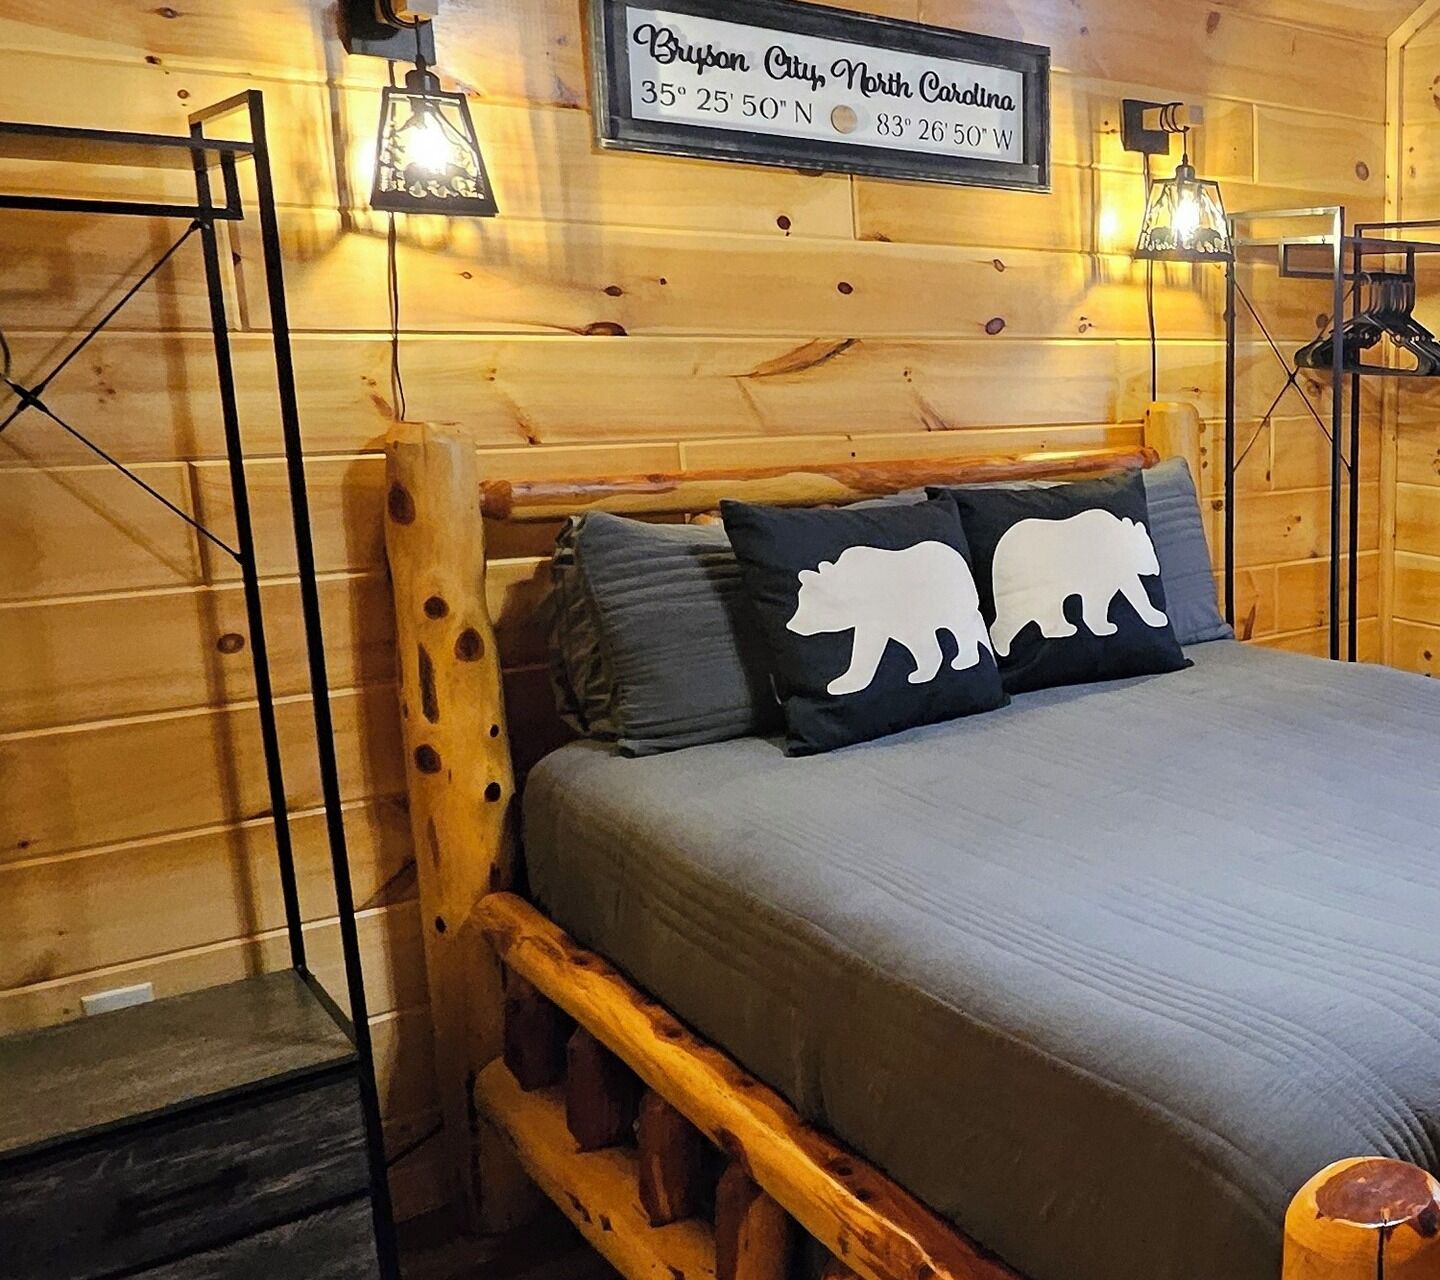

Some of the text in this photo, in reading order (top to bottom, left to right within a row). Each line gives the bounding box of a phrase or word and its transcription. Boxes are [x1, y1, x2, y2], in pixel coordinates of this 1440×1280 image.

[632, 23, 750, 75] Bryson
[830, 58, 913, 98] North
[919, 70, 1016, 112] Carolina
[794, 100, 812, 124] N
[992, 128, 1013, 151] W
